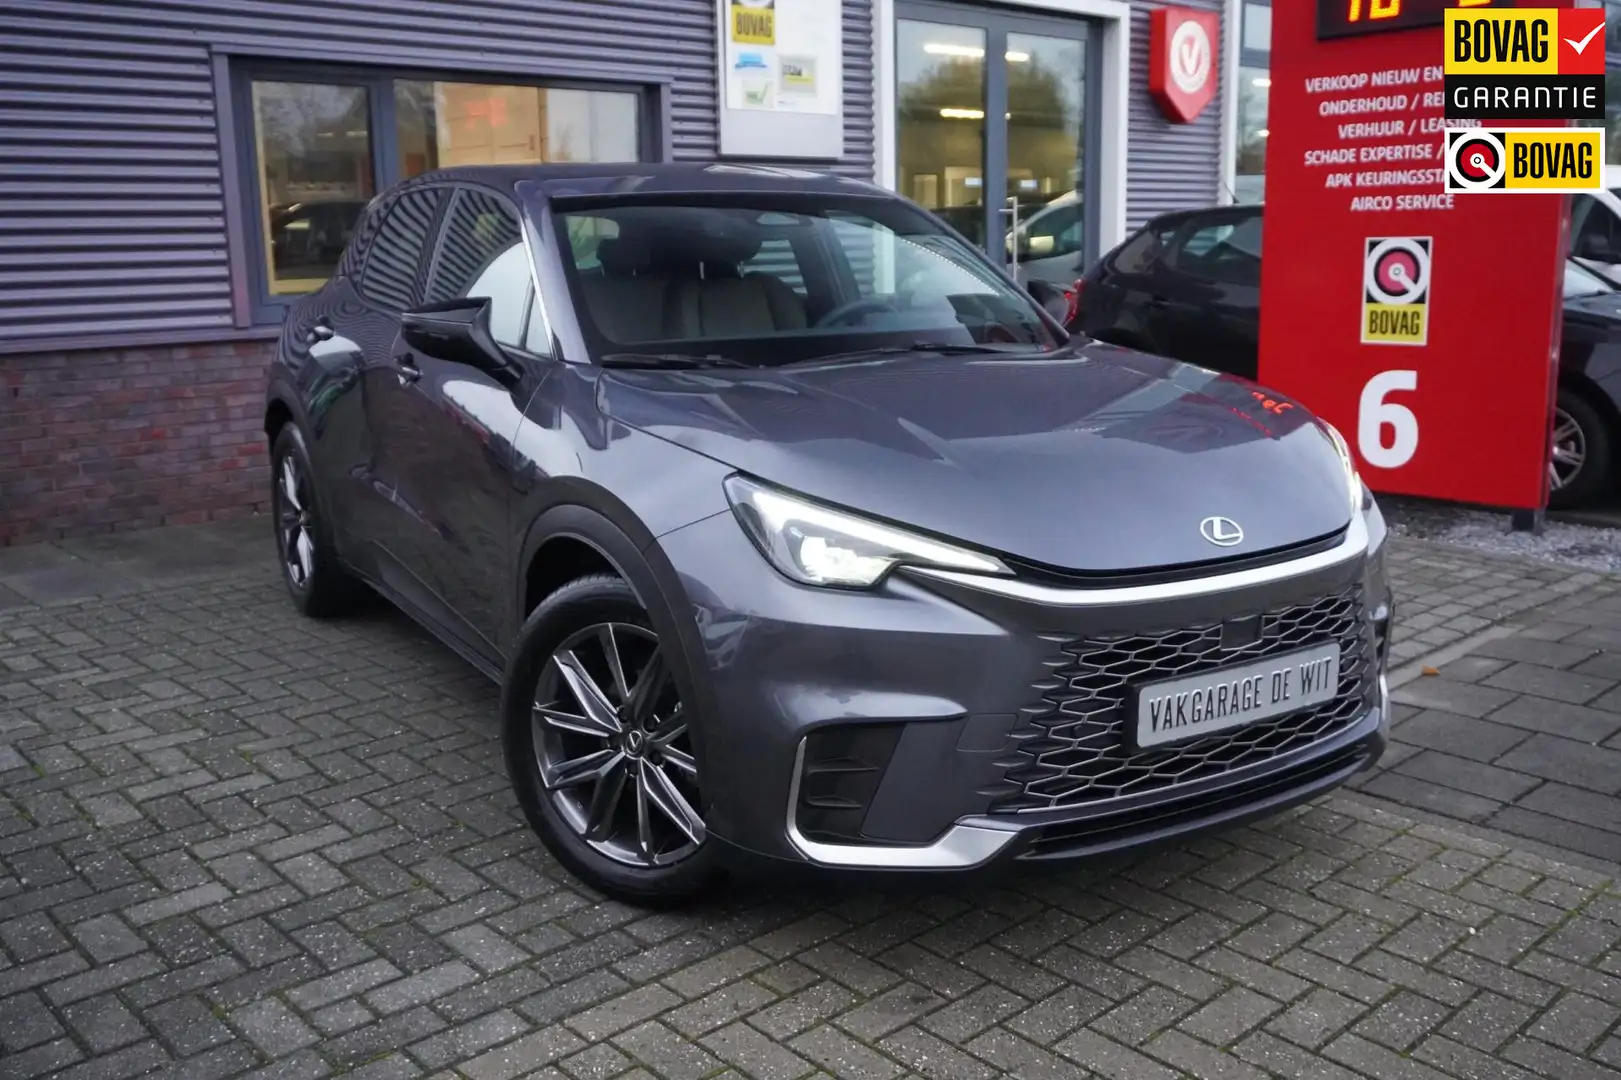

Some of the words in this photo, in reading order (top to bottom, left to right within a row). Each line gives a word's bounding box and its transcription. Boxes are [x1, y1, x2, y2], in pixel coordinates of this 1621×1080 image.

[735, 12, 772, 38] BOVAG
[1305, 73, 1368, 93] VERKOOP
[1371, 68, 1420, 86] NIEUW
[1423, 66, 1443, 82] EN
[1319, 94, 1408, 116] ONDERHOUD
[1410, 93, 1420, 111] /
[1338, 120, 1404, 139] VERHUUR
[1408, 119, 1417, 136] /
[1304, 148, 1356, 166] SCHADE
[1360, 143, 1433, 161] EXPERTISE
[1325, 172, 1353, 188] APK
[1351, 195, 1393, 211] AIRCO
[1395, 194, 1454, 210] SERVICE
[1368, 310, 1420, 336] BOVAG
[1358, 369, 1419, 469] 6
[1149, 674, 1264, 733] VAKGARAGE
[1271, 668, 1292, 704] DE
[1299, 656, 1333, 696] WIT
